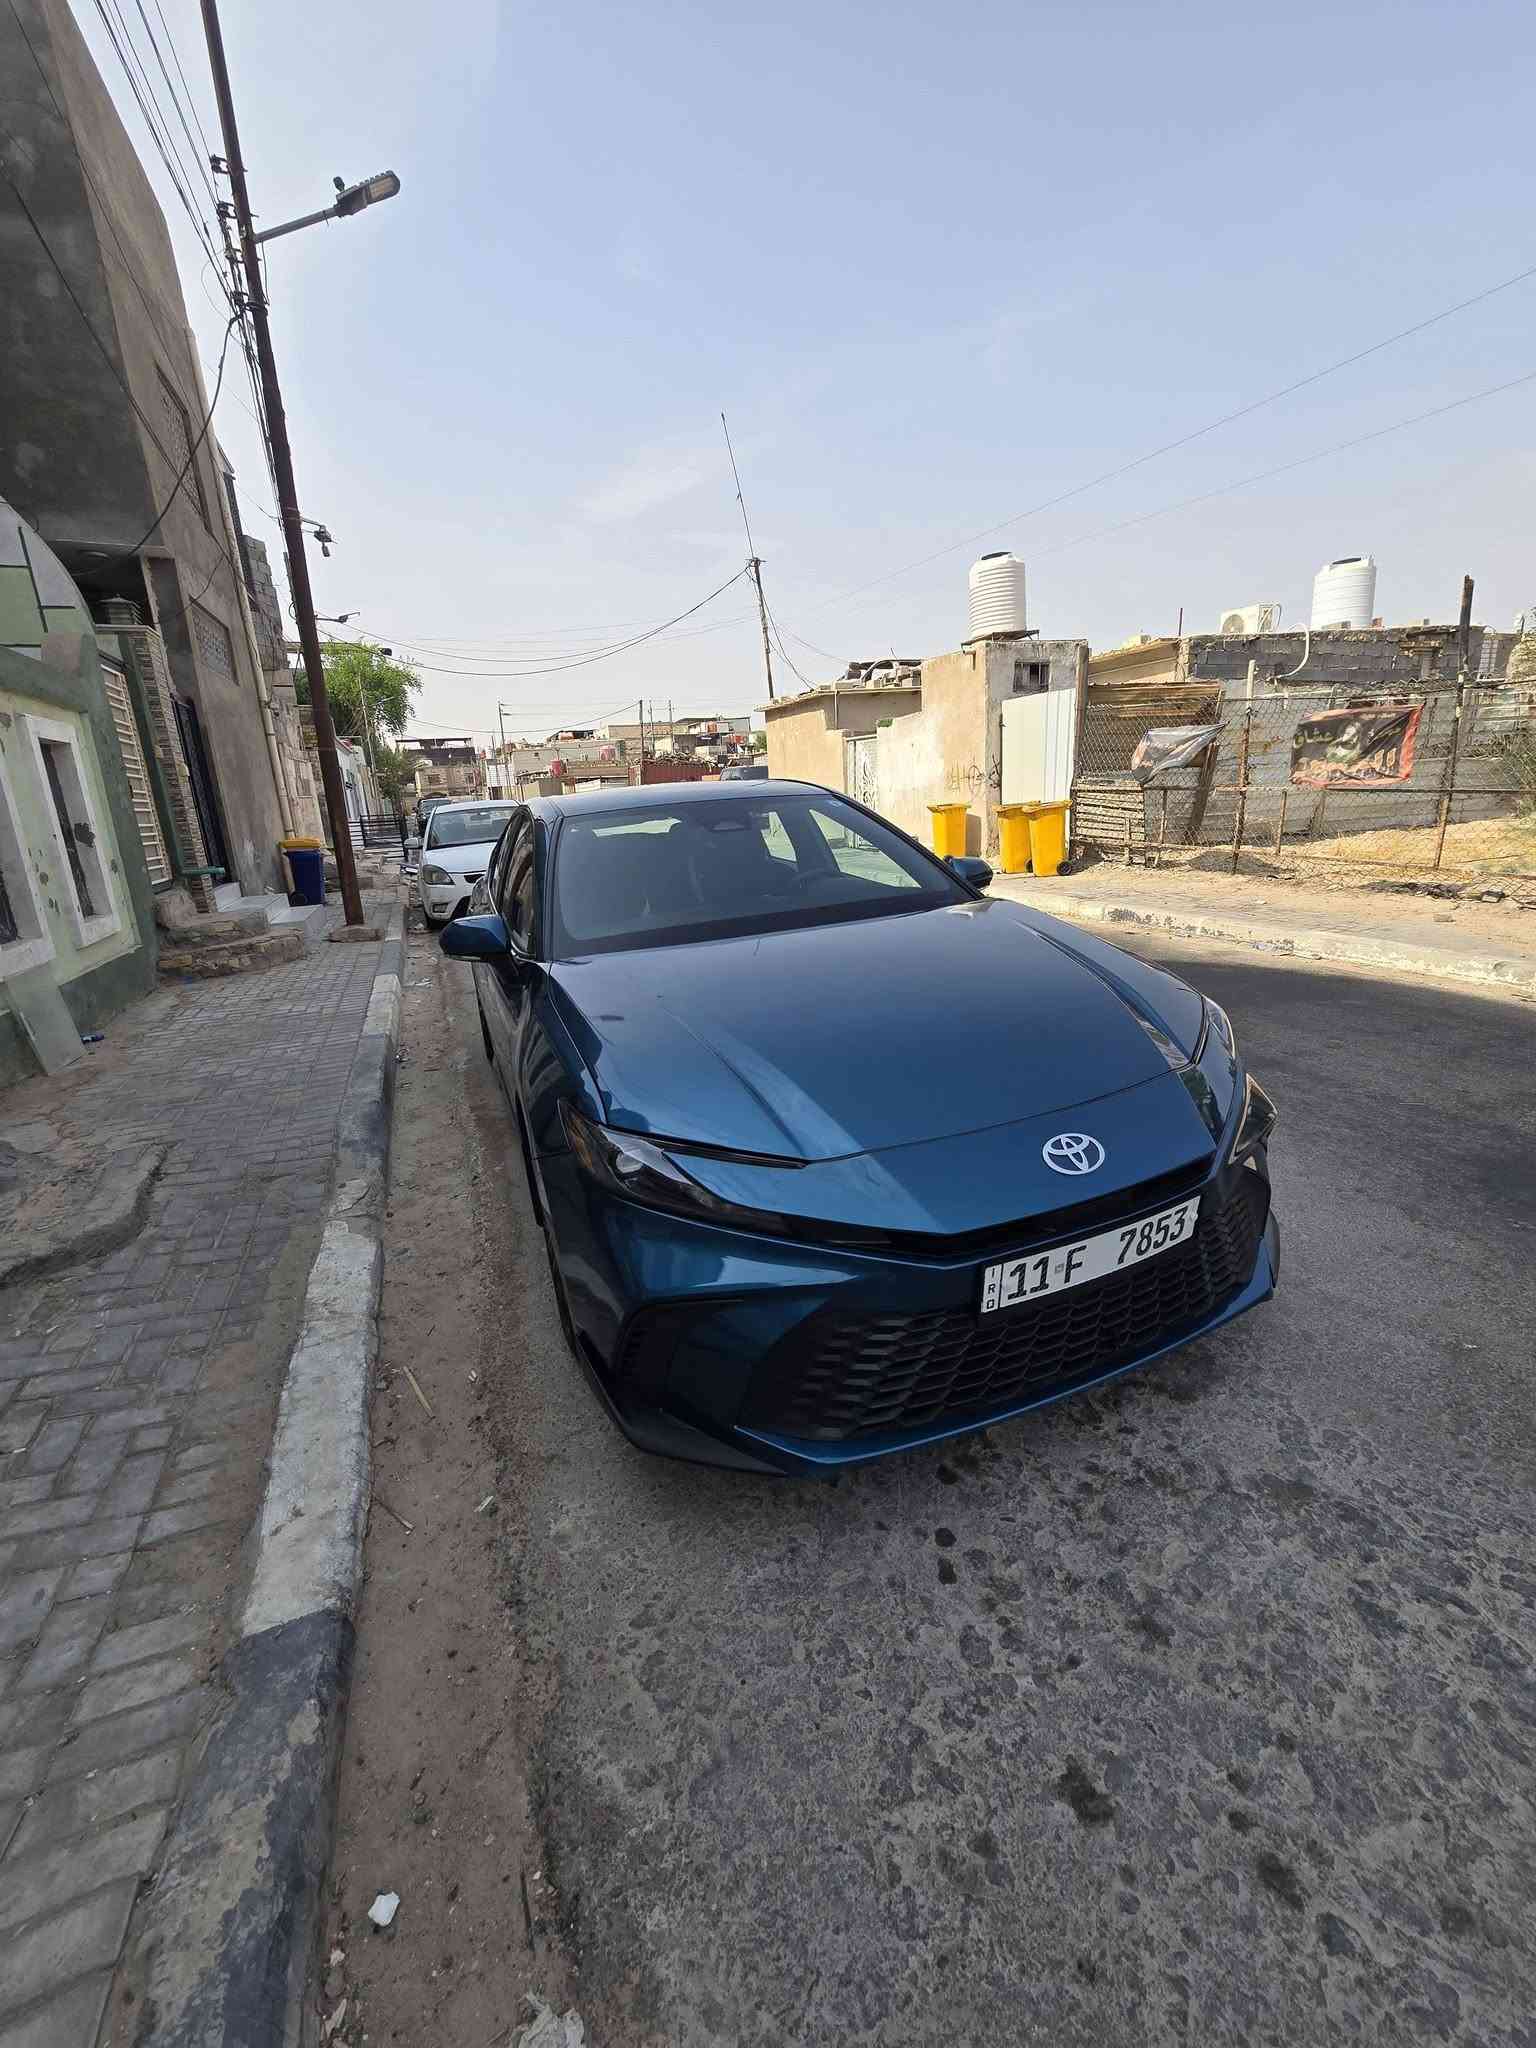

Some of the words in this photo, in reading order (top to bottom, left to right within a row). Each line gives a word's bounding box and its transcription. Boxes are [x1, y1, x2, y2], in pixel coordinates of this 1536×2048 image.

[1007, 1256, 1050, 1300] 11
[1063, 1245, 1087, 1284] F
[1117, 1206, 1188, 1265] 7853
